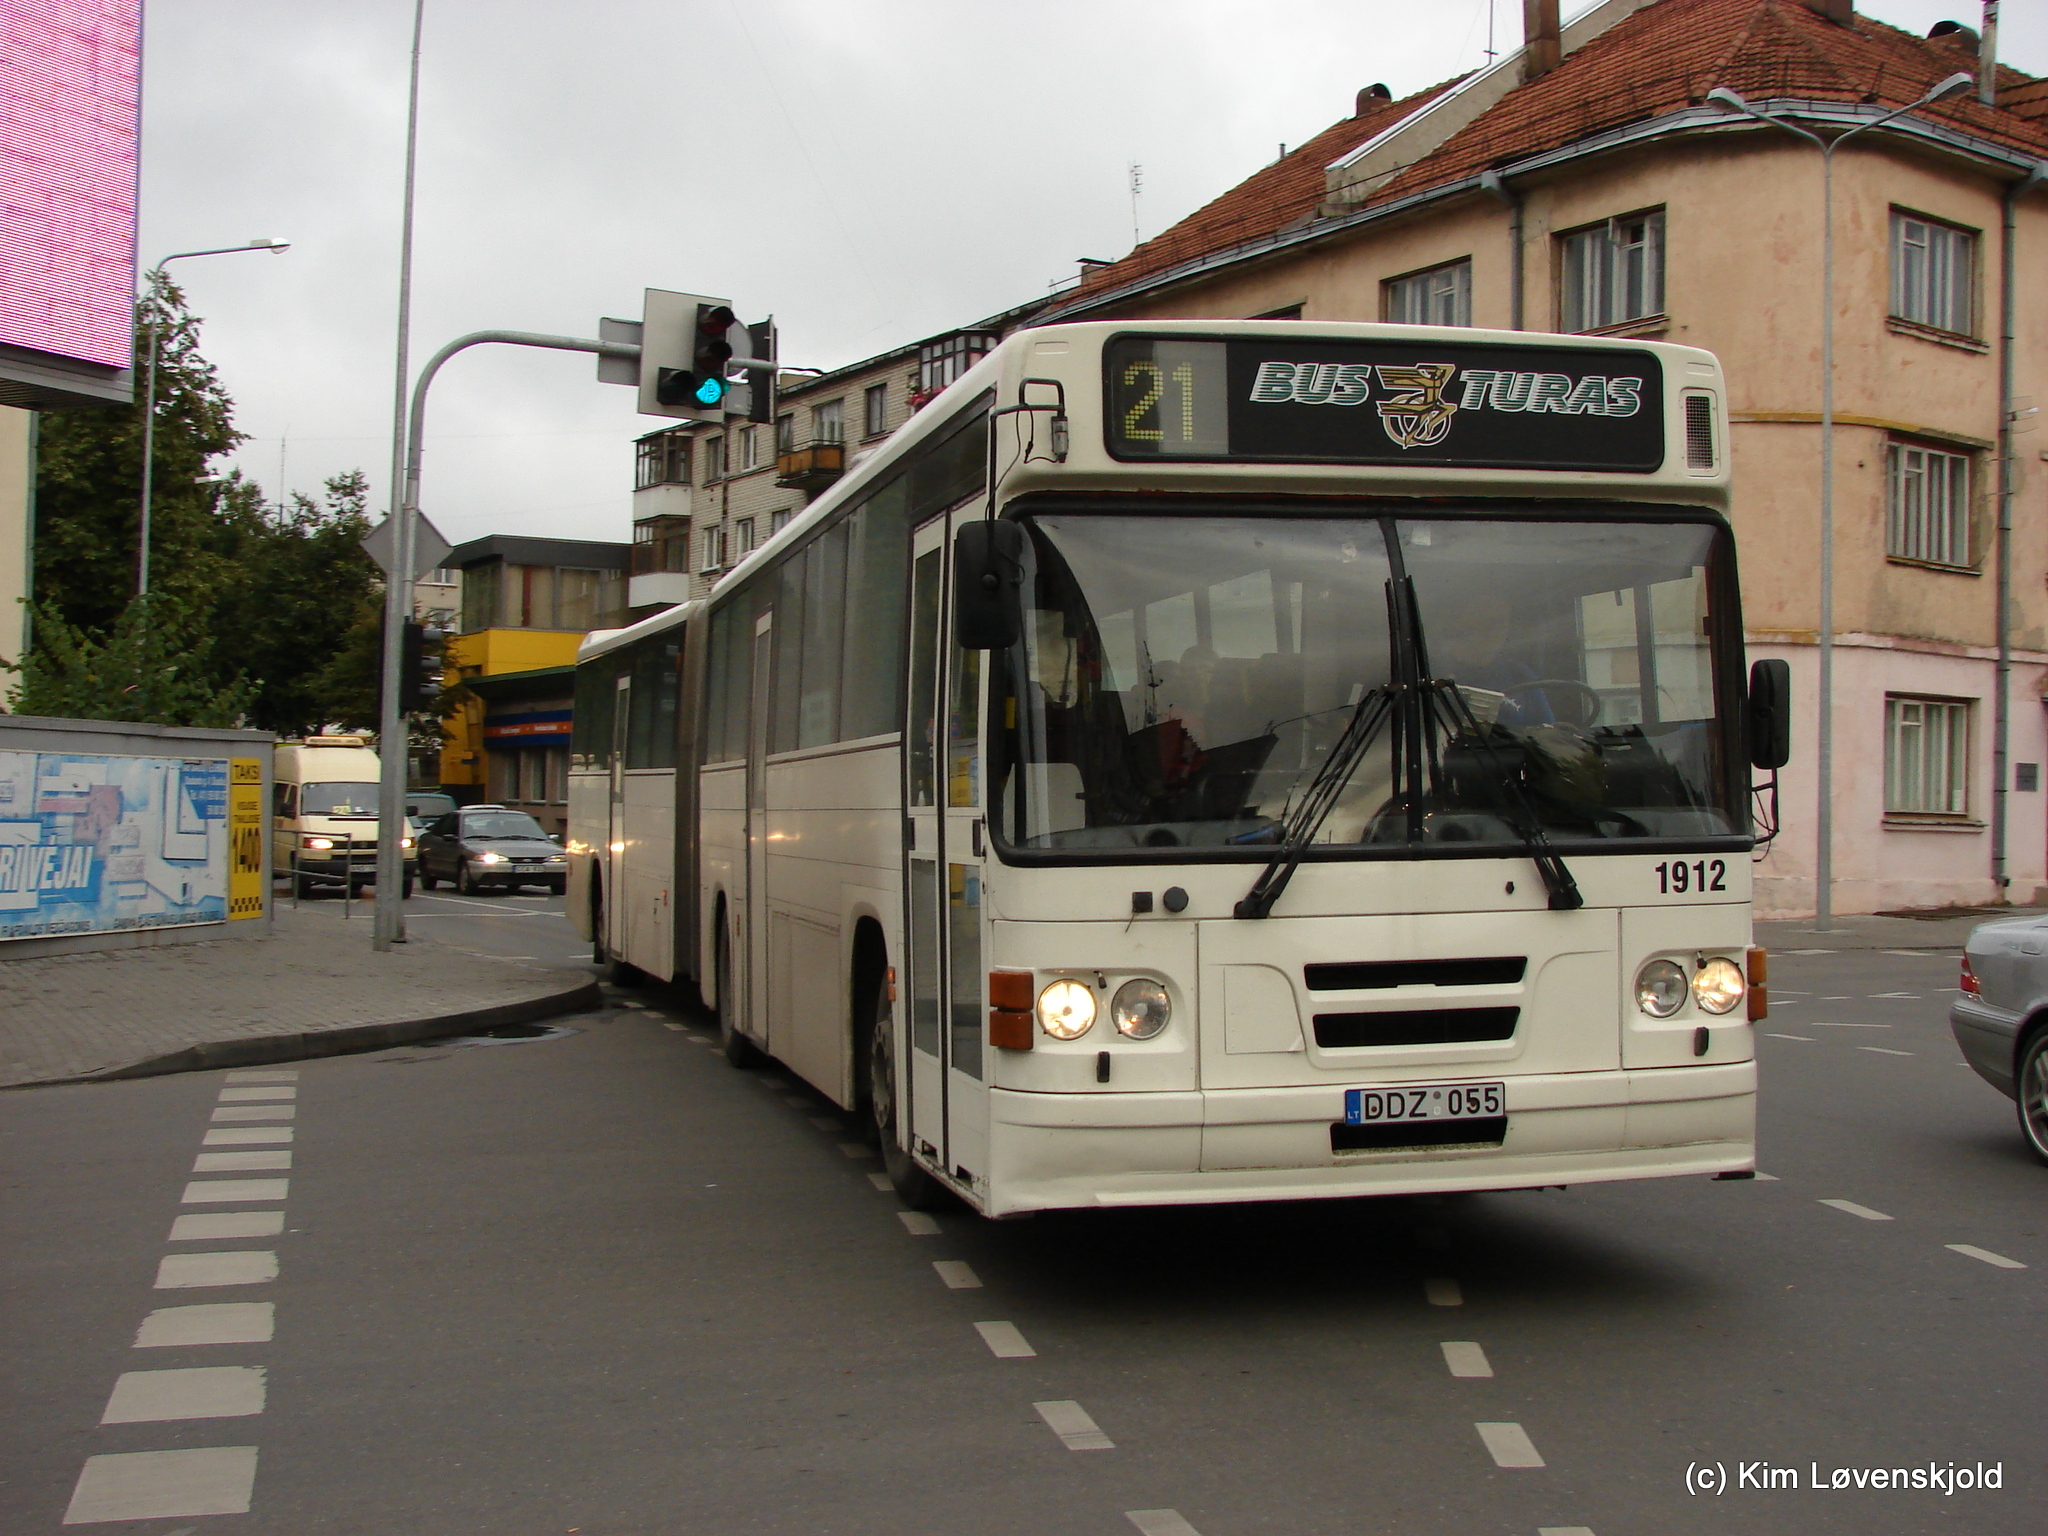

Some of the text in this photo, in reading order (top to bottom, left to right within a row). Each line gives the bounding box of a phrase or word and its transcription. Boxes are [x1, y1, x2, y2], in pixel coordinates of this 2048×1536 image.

[1124, 361, 1193, 441] 21
[1249, 362, 1643, 418] BUS TURAS
[1655, 859, 1726, 894] 1912
[1347, 1087, 1499, 1120] LT DDZ 055
